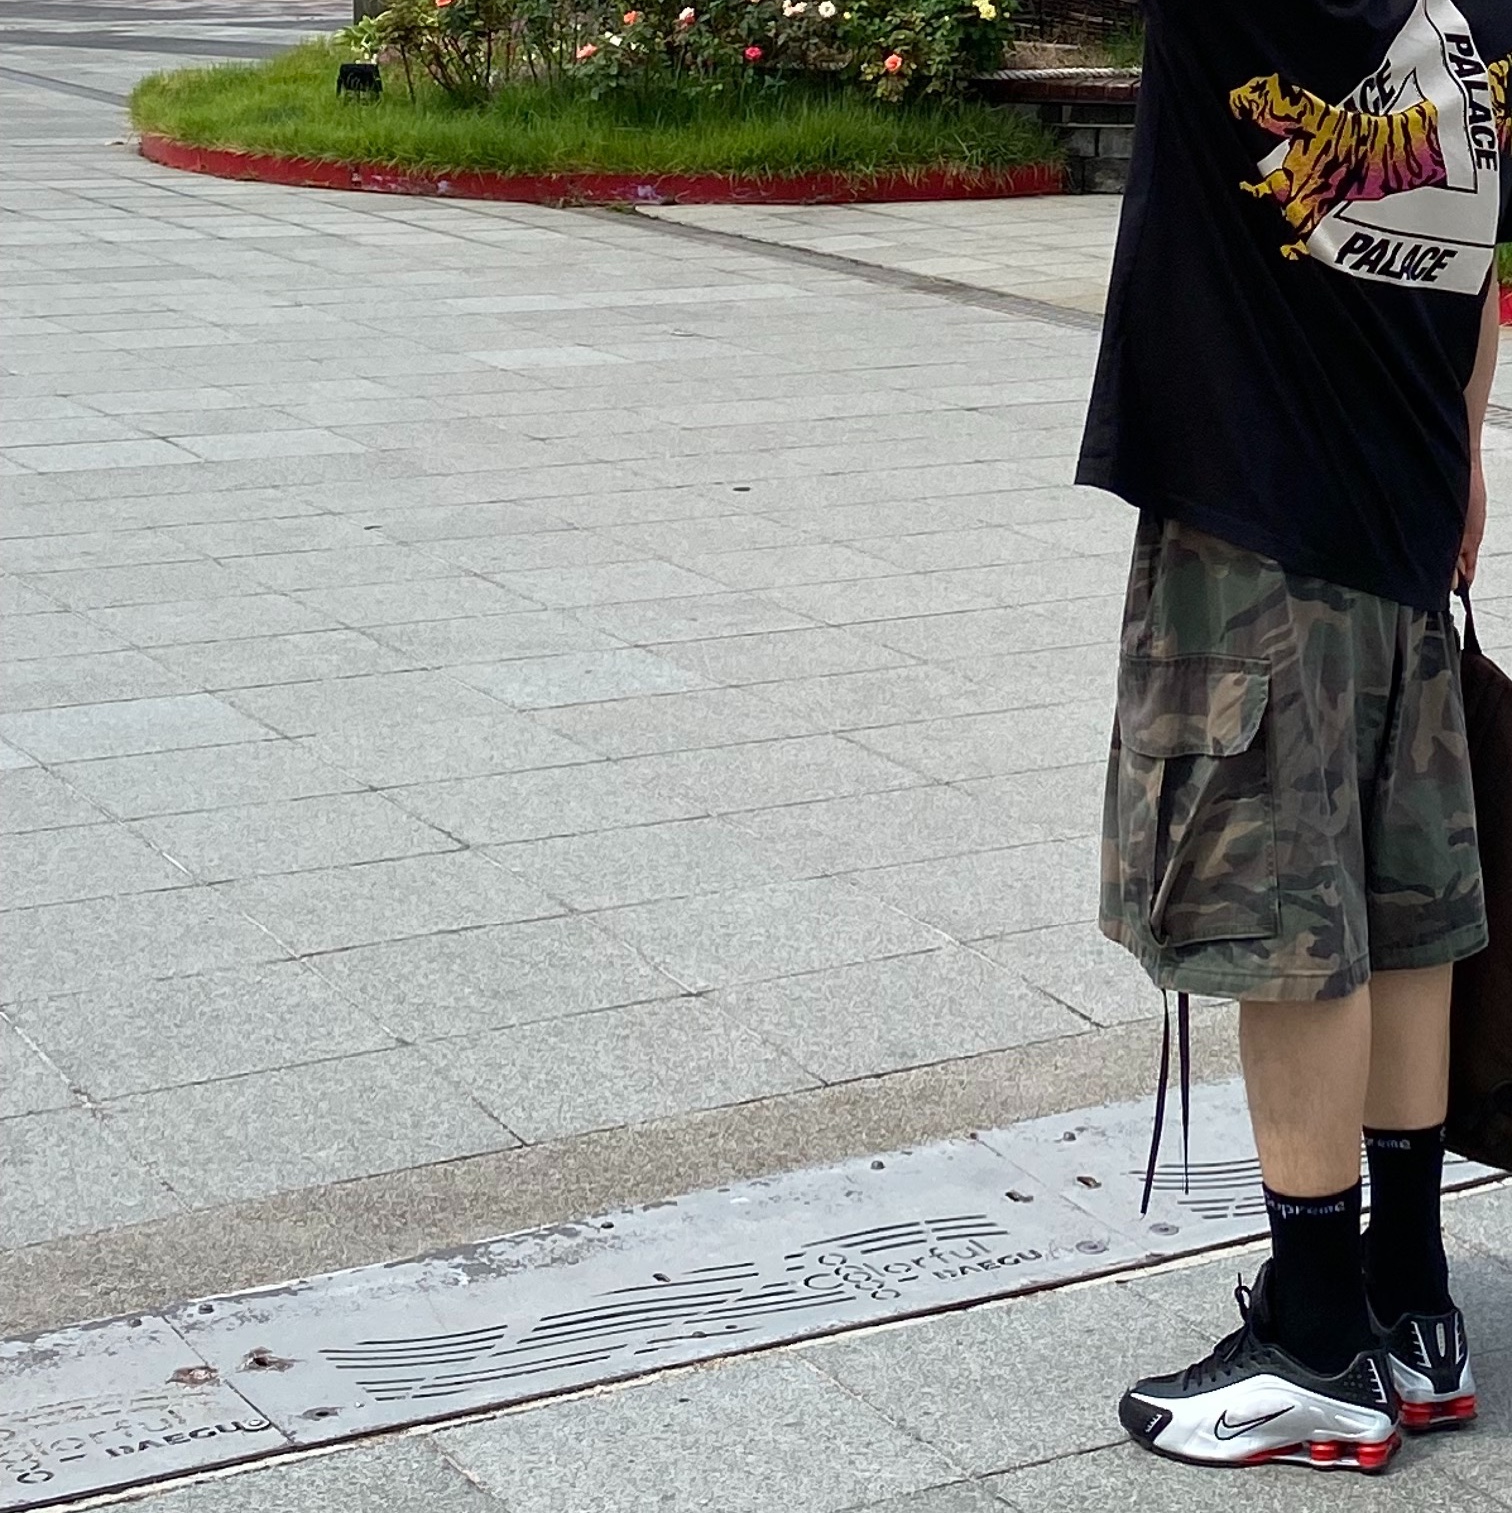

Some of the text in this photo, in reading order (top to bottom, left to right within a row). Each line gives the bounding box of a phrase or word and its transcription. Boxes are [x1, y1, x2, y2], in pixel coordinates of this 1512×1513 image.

[1444, 32, 1499, 172] PALACE
[1335, 232, 1458, 283] PALACE
[932, 1249, 1042, 1280] DAEGU
[104, 1419, 246, 1458] DAEGU
